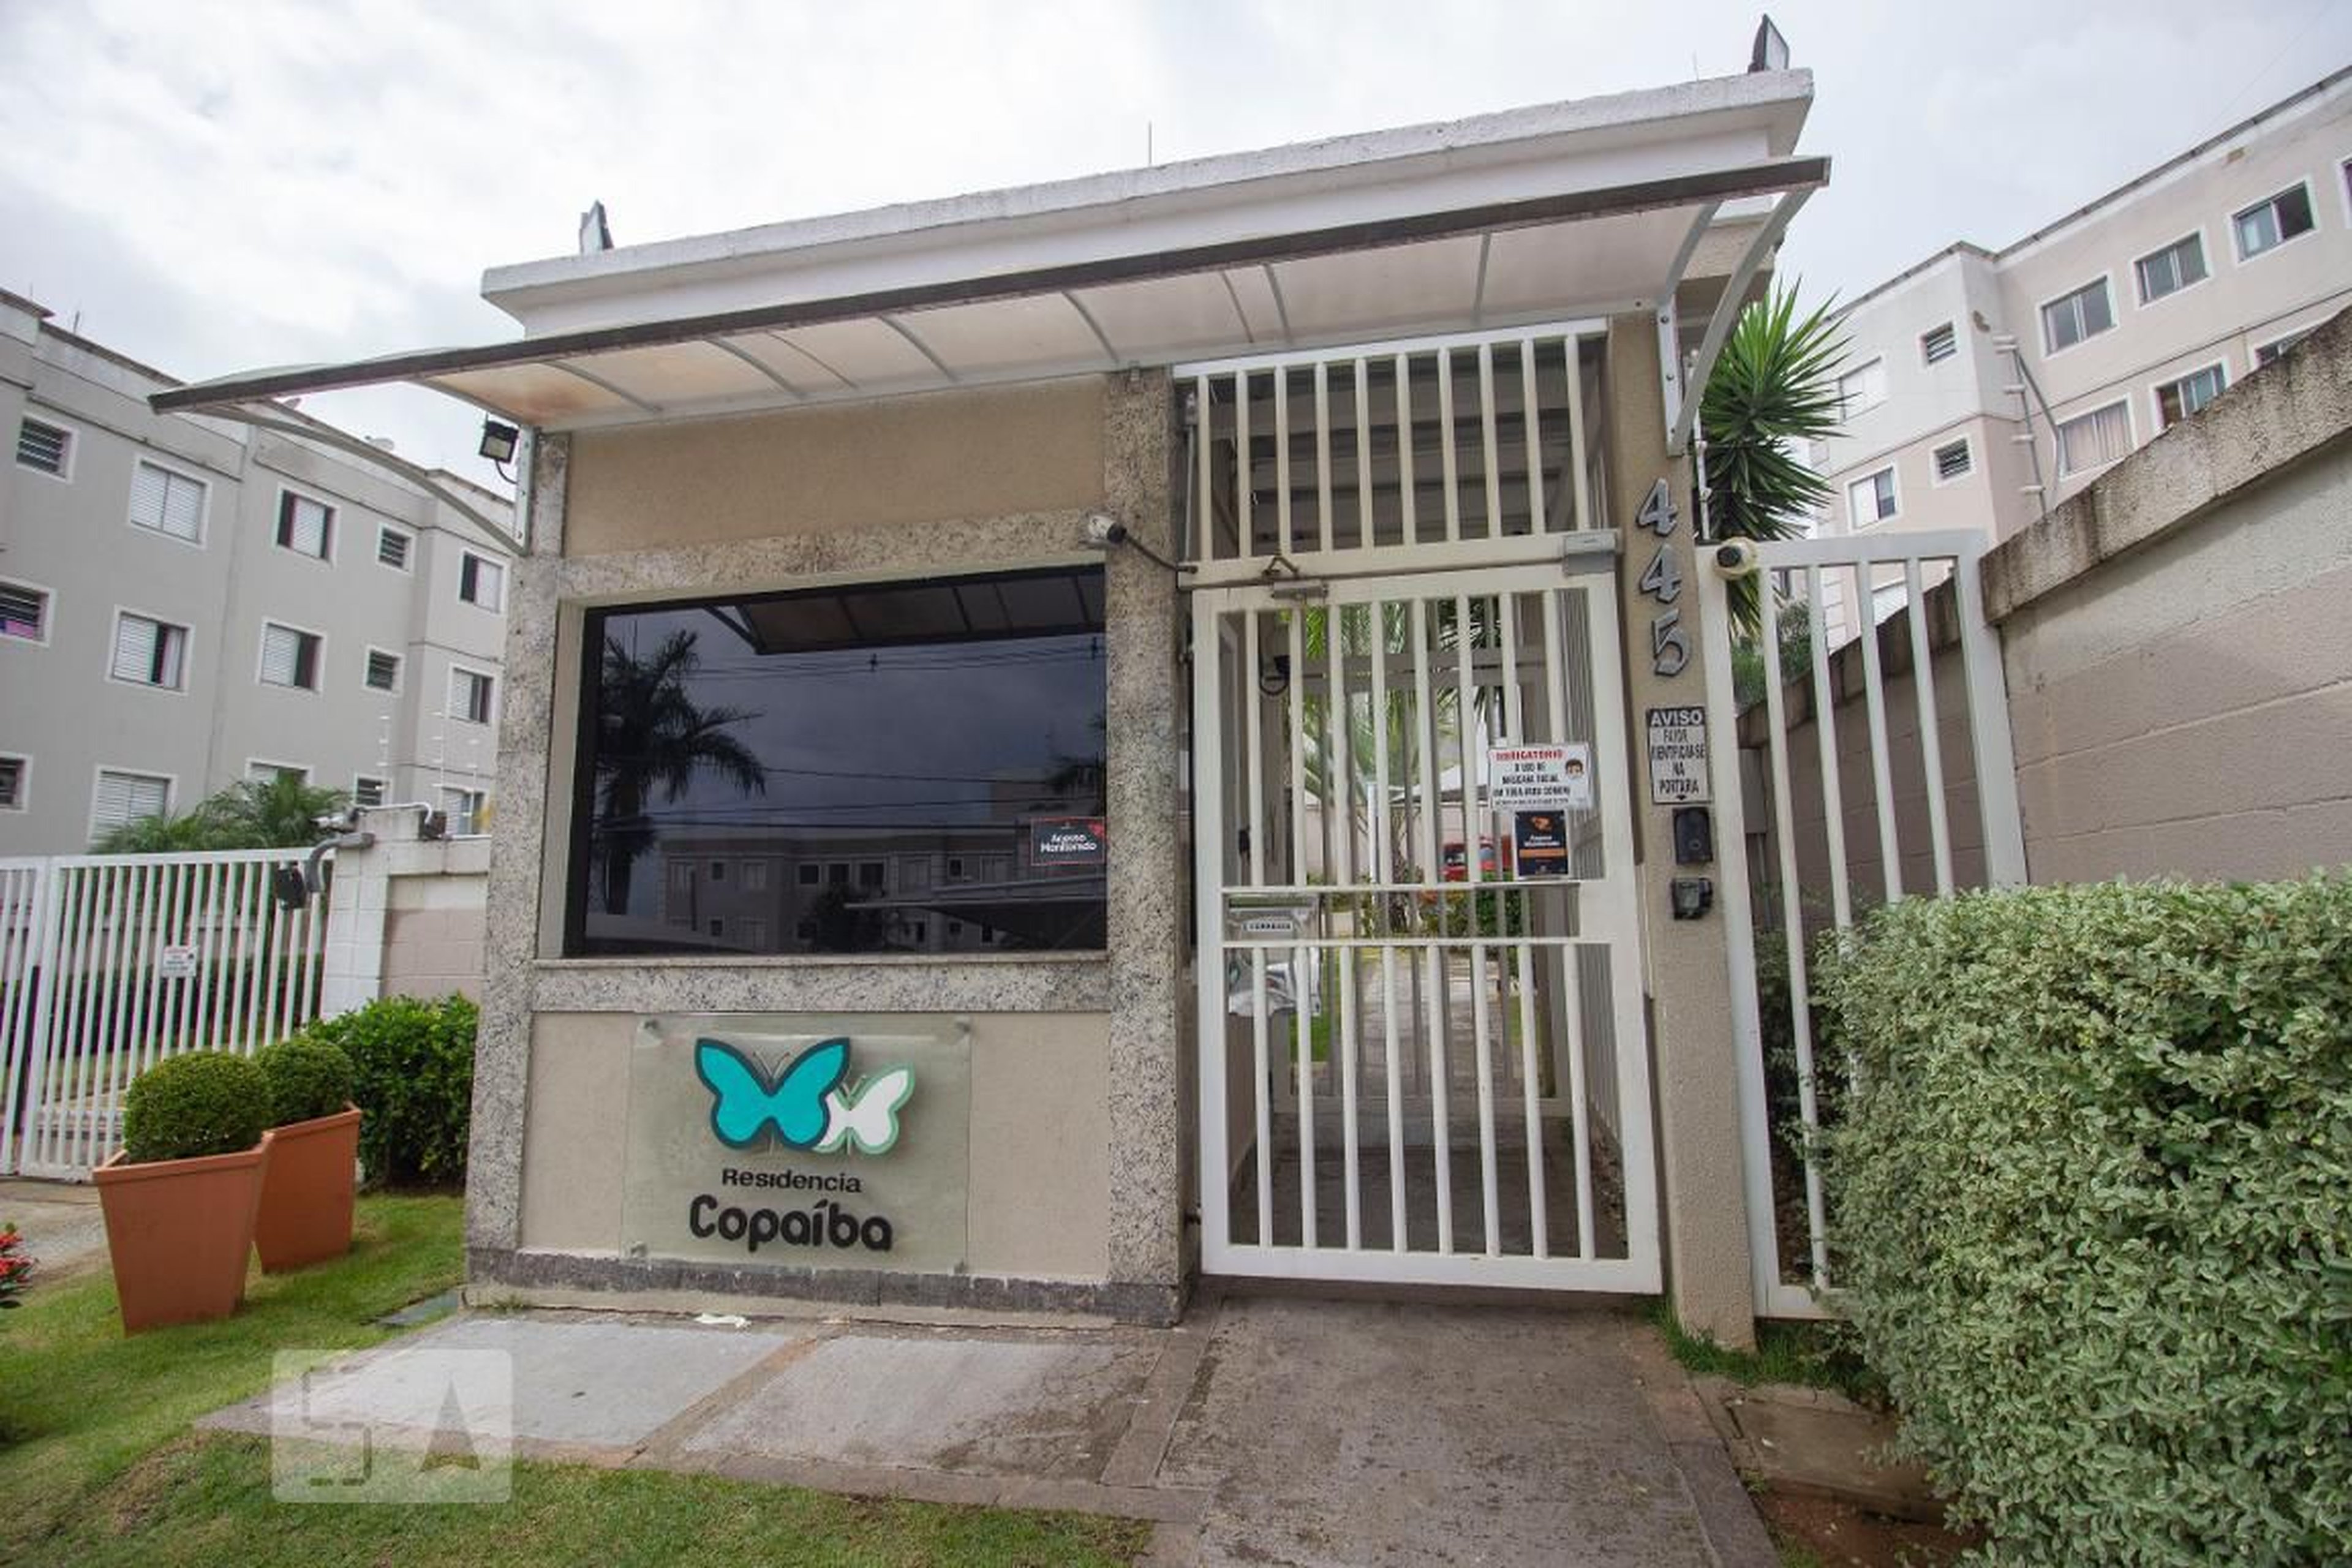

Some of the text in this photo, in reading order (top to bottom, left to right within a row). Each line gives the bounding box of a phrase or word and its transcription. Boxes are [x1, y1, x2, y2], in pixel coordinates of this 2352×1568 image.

[1651, 709, 1702, 726] AVISO
[1664, 729, 1688, 743] FAVOR
[1673, 761, 1685, 776] NA
[722, 1167, 862, 1193] Residencia
[689, 1194, 894, 1253] Copaíba
